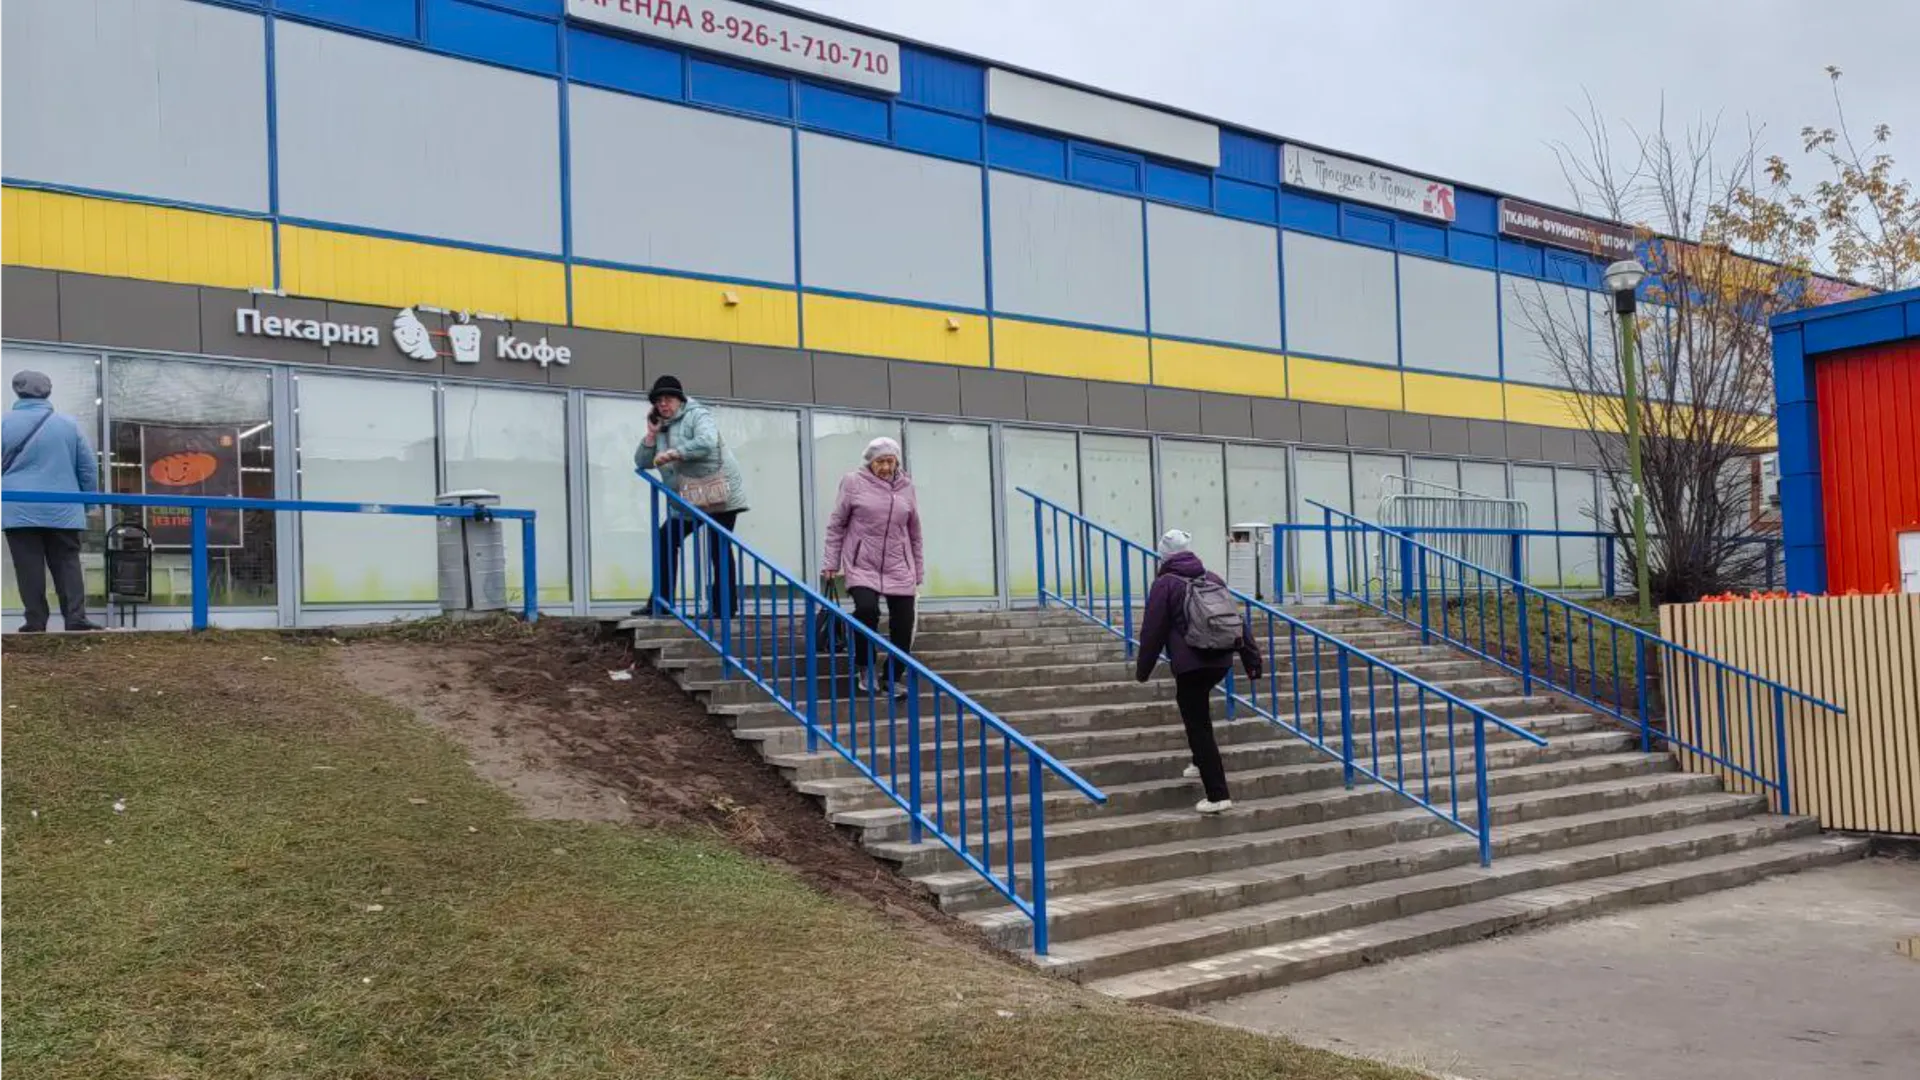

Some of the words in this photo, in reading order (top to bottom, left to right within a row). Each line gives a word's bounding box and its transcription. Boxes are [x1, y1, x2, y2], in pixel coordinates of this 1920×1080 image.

[581, 0, 693, 28] ЕНДА
[701, 10, 888, 75] 8-926-1-710-710
[235, 308, 380, 346] Пекарня
[497, 335, 572, 367] Кофе
